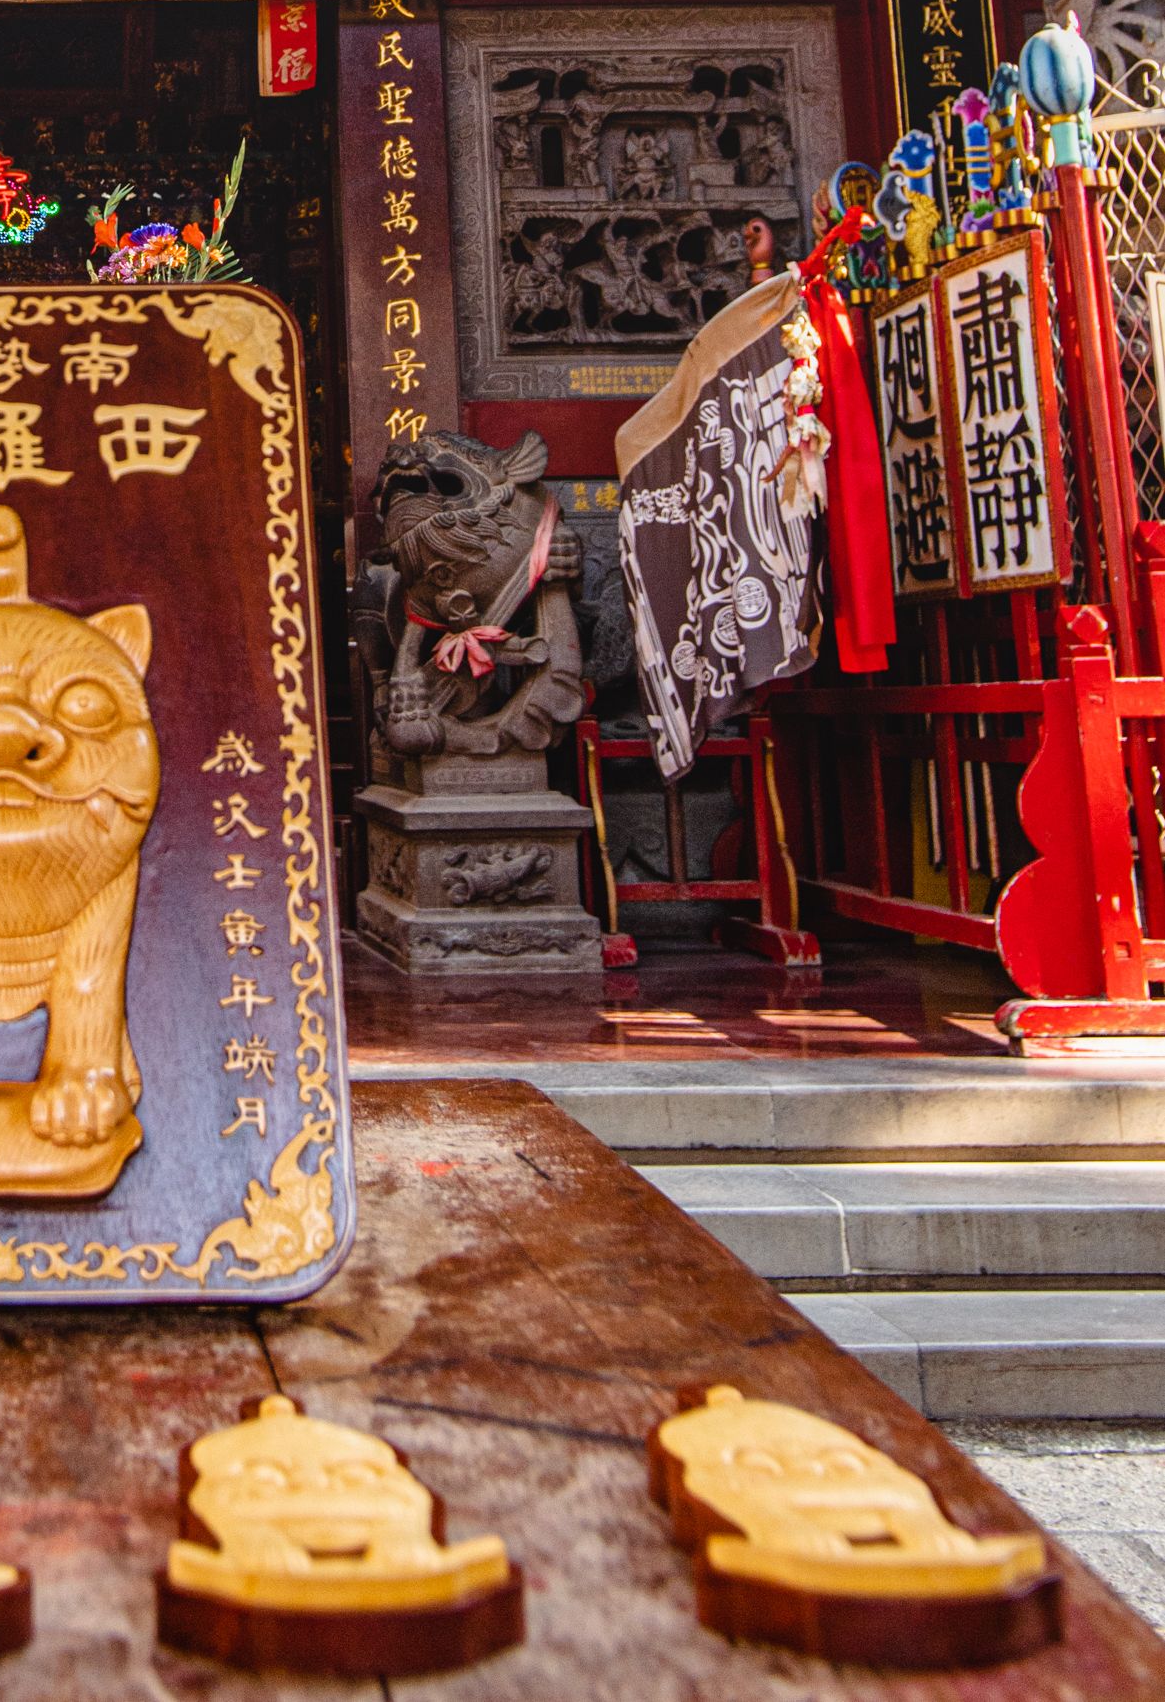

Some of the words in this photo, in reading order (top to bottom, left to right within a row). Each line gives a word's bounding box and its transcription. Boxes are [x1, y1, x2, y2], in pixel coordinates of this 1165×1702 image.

[953, 270, 1042, 570] 肅靜
[202, 730, 278, 1139] 歲次壬寅年端月
